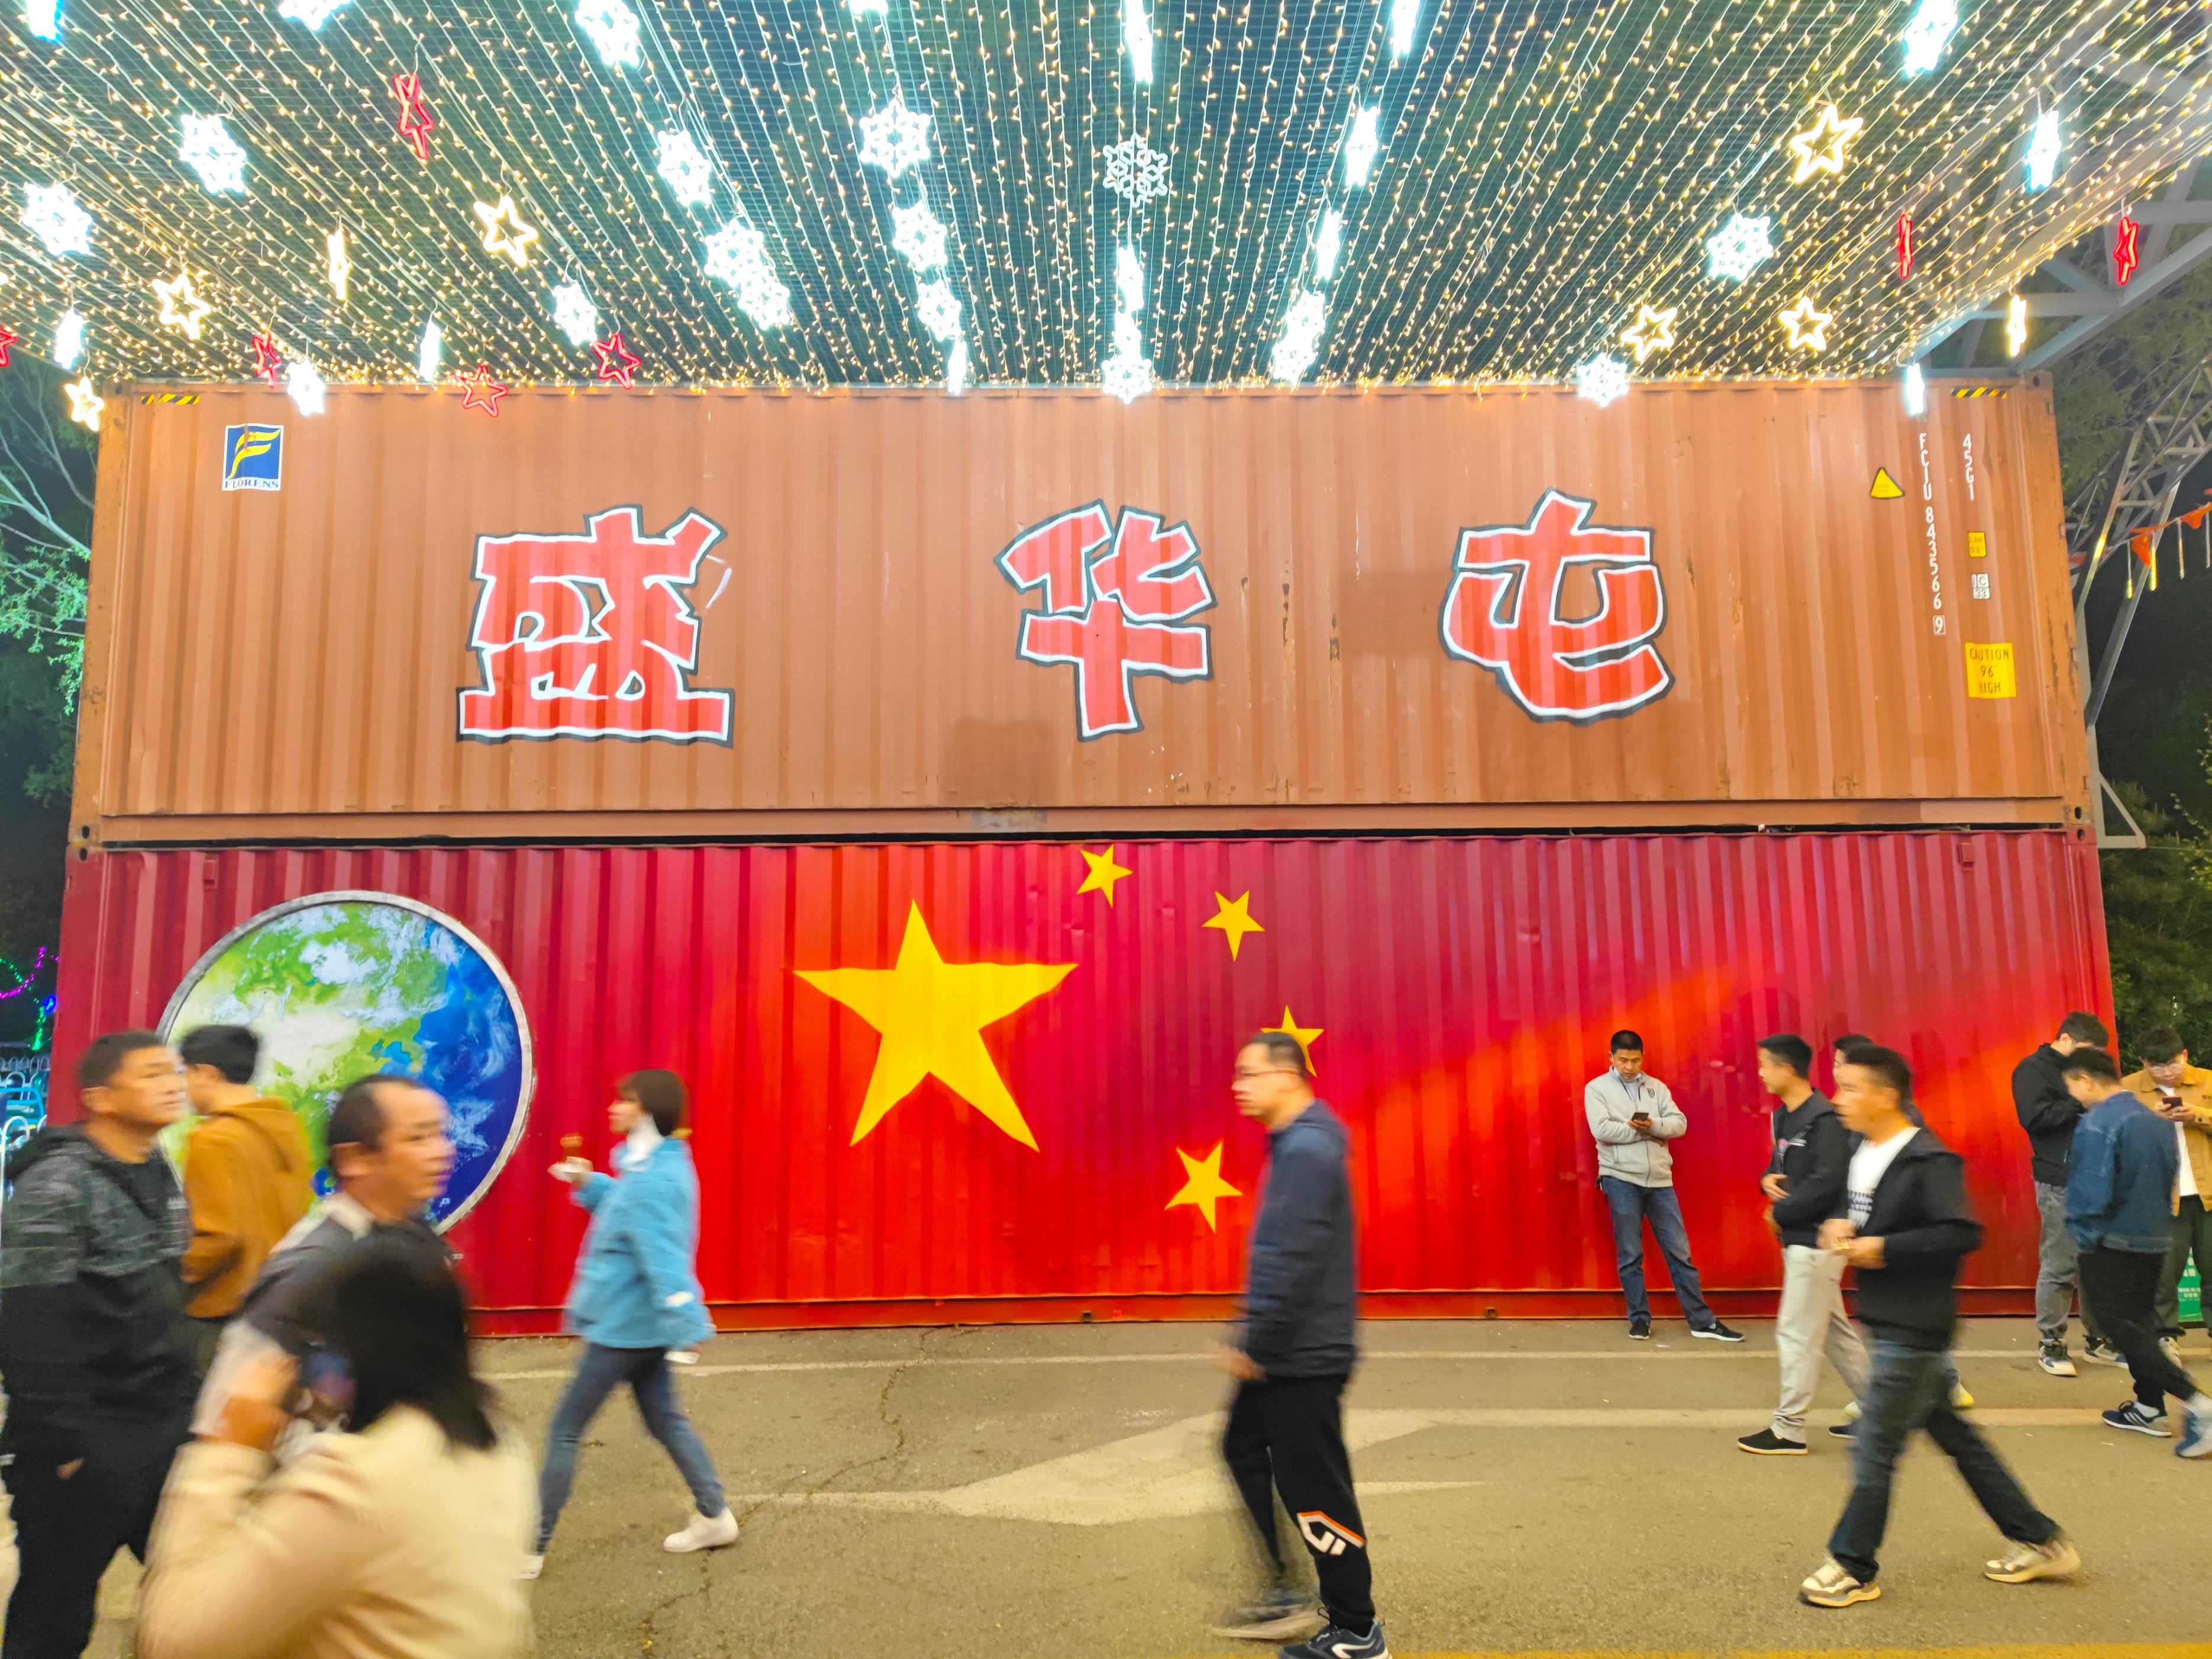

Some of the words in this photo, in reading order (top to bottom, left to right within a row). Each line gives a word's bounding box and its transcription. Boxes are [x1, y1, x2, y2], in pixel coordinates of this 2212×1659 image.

[1962, 432, 1975, 501] 45G1
[224, 479, 279, 489] FLORENS
[1969, 648, 2009, 661] CAUTION
[1979, 681, 2001, 693] HIGH
